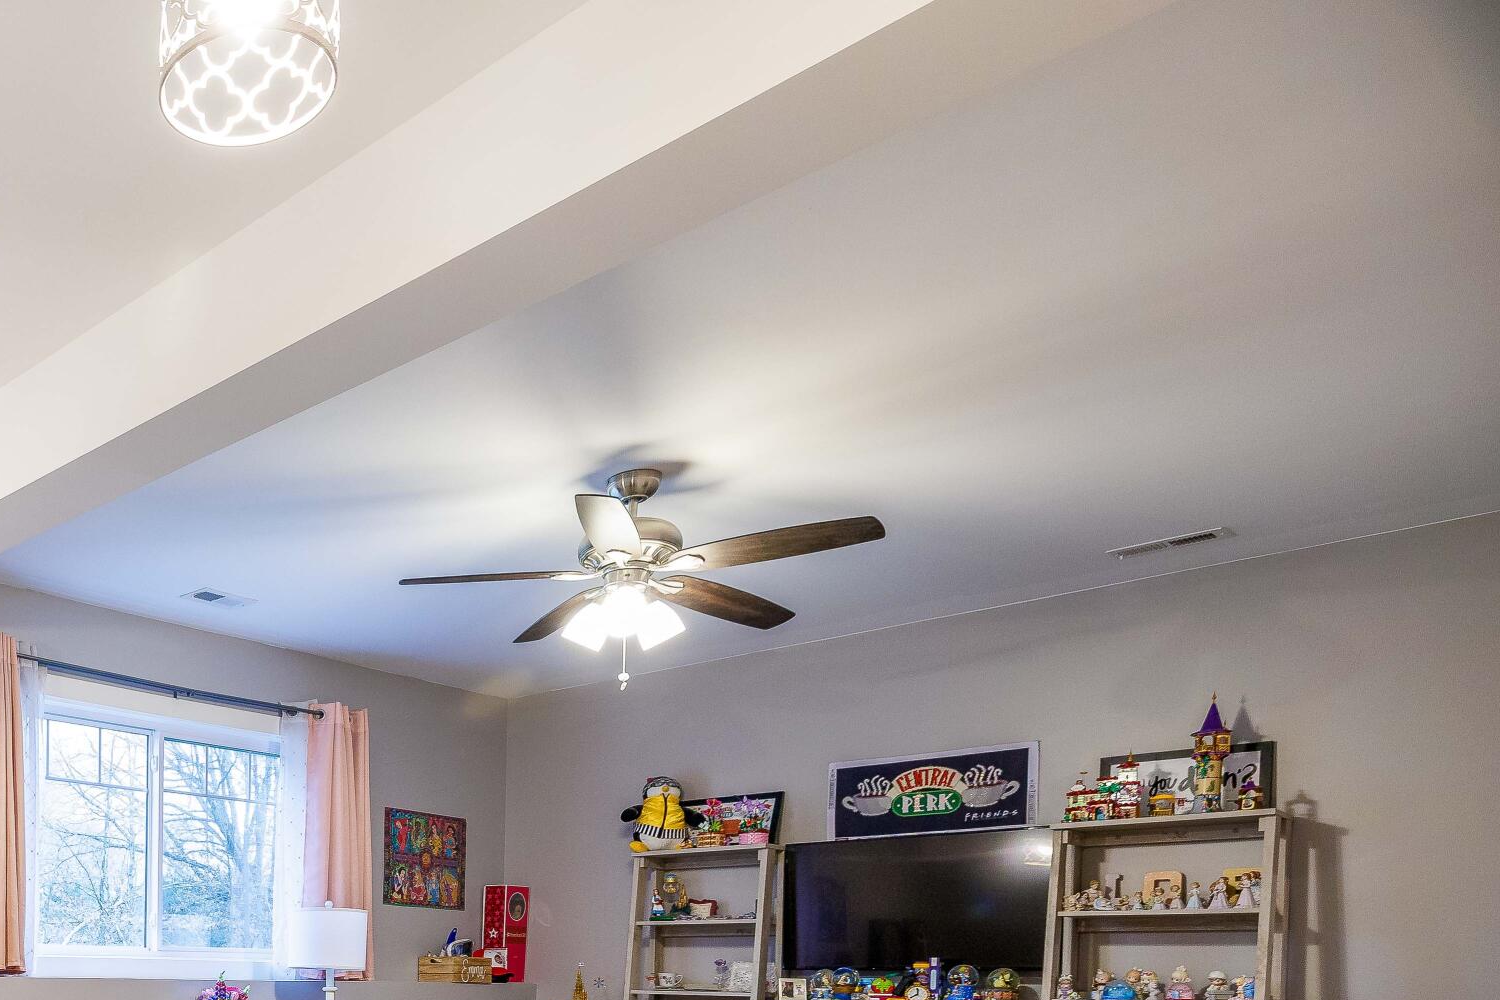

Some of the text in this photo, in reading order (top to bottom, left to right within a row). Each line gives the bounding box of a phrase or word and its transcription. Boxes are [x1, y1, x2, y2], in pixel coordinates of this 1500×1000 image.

[895, 767, 956, 792] CENTRAL
[1147, 775, 1178, 797] you
[1178, 763, 1258, 792] dn'?
[901, 793, 954, 814] PERK
